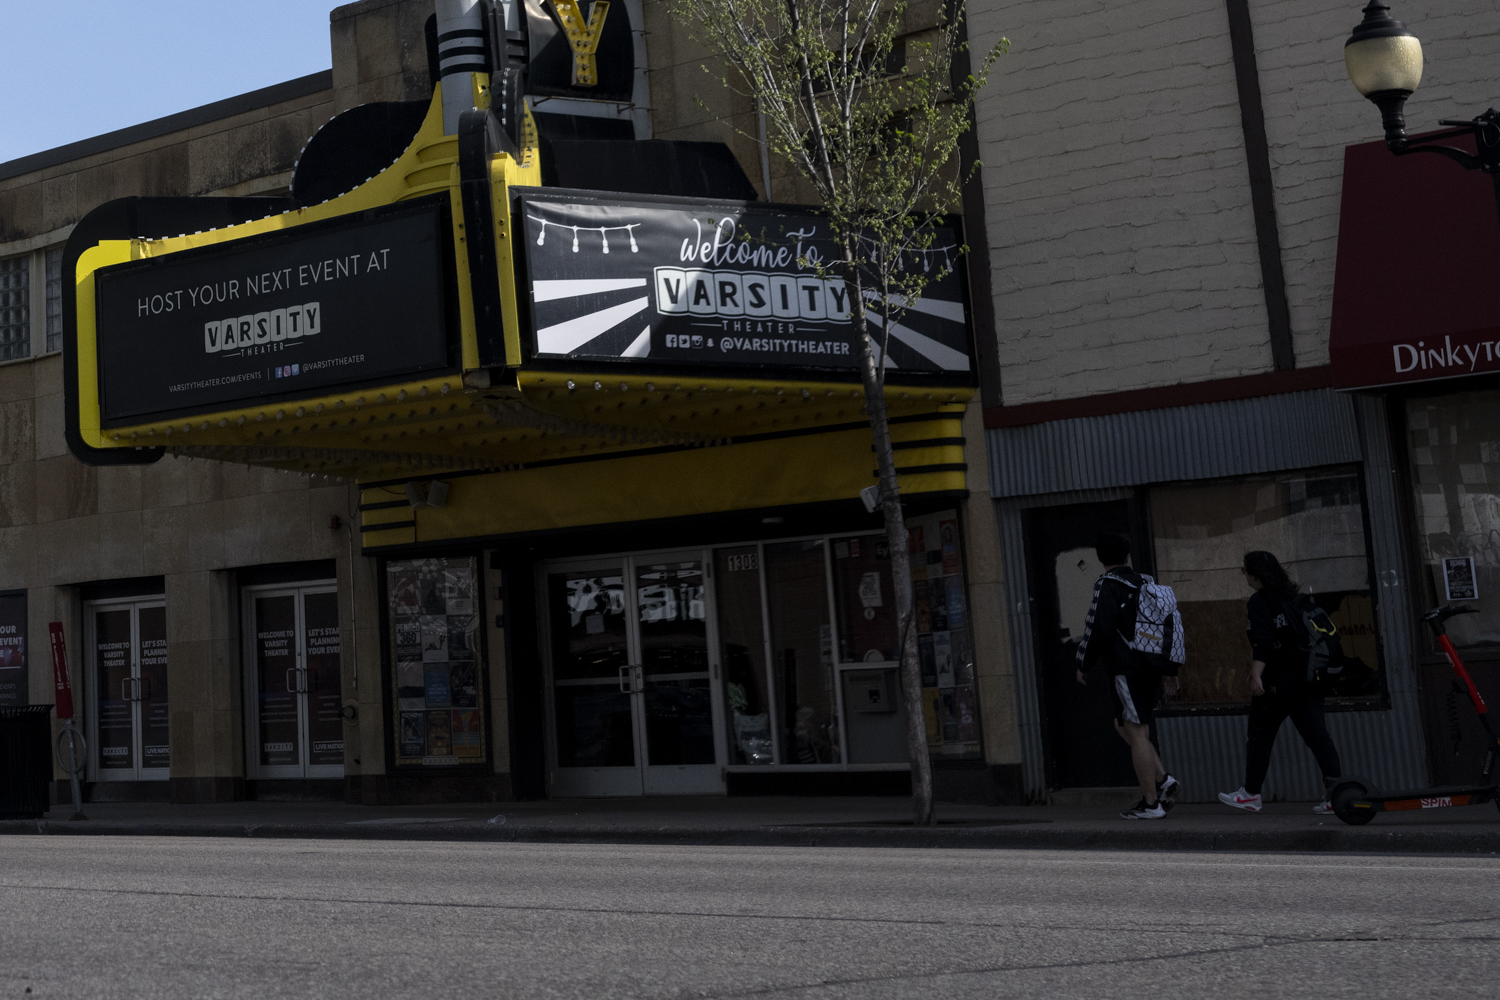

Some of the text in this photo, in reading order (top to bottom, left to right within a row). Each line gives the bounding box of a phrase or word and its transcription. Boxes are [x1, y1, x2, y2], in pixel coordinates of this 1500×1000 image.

[786, 226, 824, 270] to
[137, 248, 391, 317] HOST YOUR NEXT EVENT AT
[661, 274, 851, 315] VARSITY
[206, 305, 319, 349] VARSITY
[722, 320, 795, 334] THEATER
[240, 342, 285, 357] THEATER
[720, 337, 850, 356] @VARSITYTHEATER
[168, 354, 365, 393] VARSITYTHEATER.COM/EVENTS @VARSITYTHEATER
[308, 628, 324, 636] LET'S
[0, 636, 24, 646] EVENT
[264, 639, 288, 648] VARSITY
[400, 632, 417, 644] 360
[122, 641, 130, 649] TO
[103, 650, 125, 658] VARSITY
[264, 649, 289, 657] THEATER
[307, 647, 326, 655] YOUR
[103, 659, 125, 667] THEATER
[1421, 797, 1451, 807] SPIN
